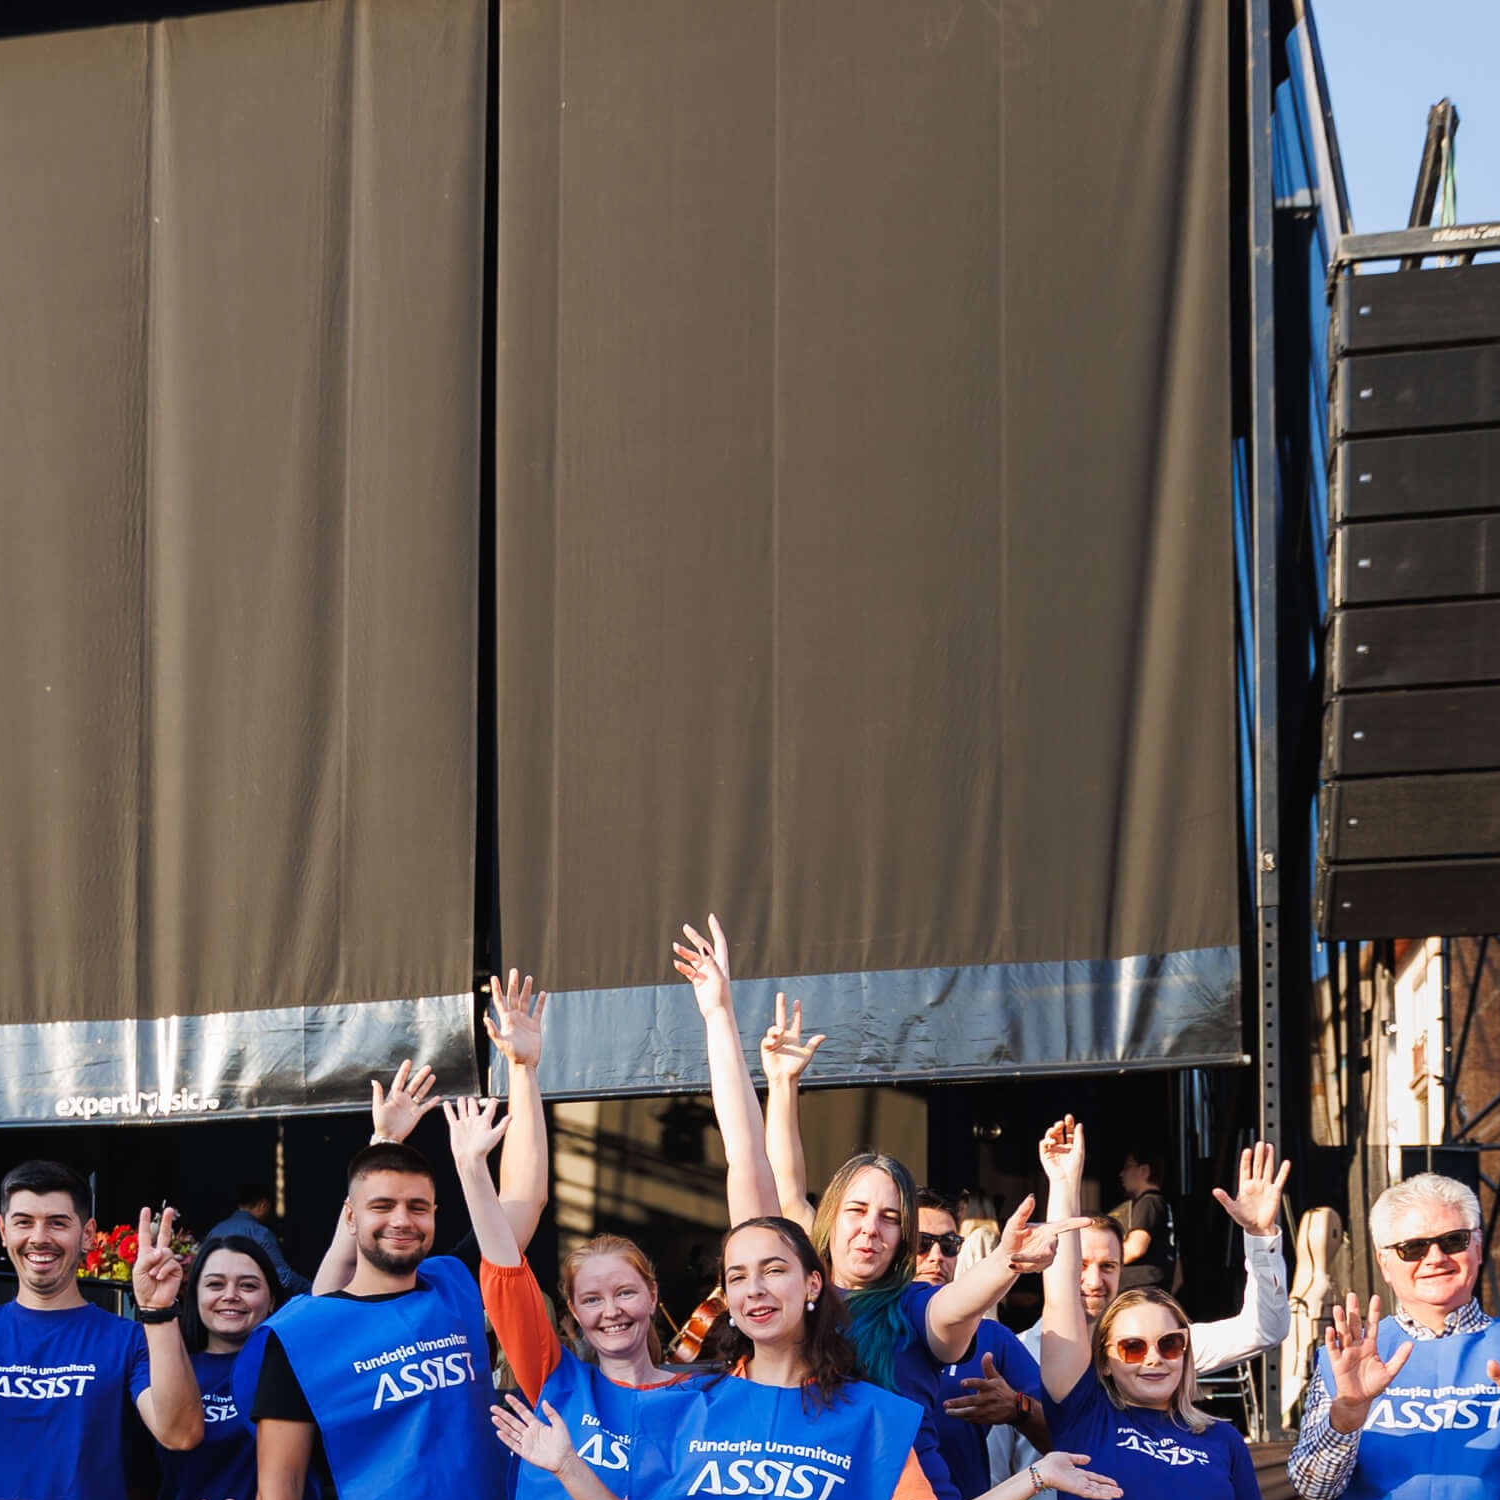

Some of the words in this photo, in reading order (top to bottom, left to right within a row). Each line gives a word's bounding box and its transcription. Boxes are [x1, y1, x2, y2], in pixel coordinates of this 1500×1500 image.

[39, 1364, 97, 1376] Umanitară
[353, 1345, 417, 1374] Fundația
[373, 1352, 476, 1411] ASSIST
[689, 1440, 762, 1457] Fundația
[765, 1441, 853, 1471] Umanitară
